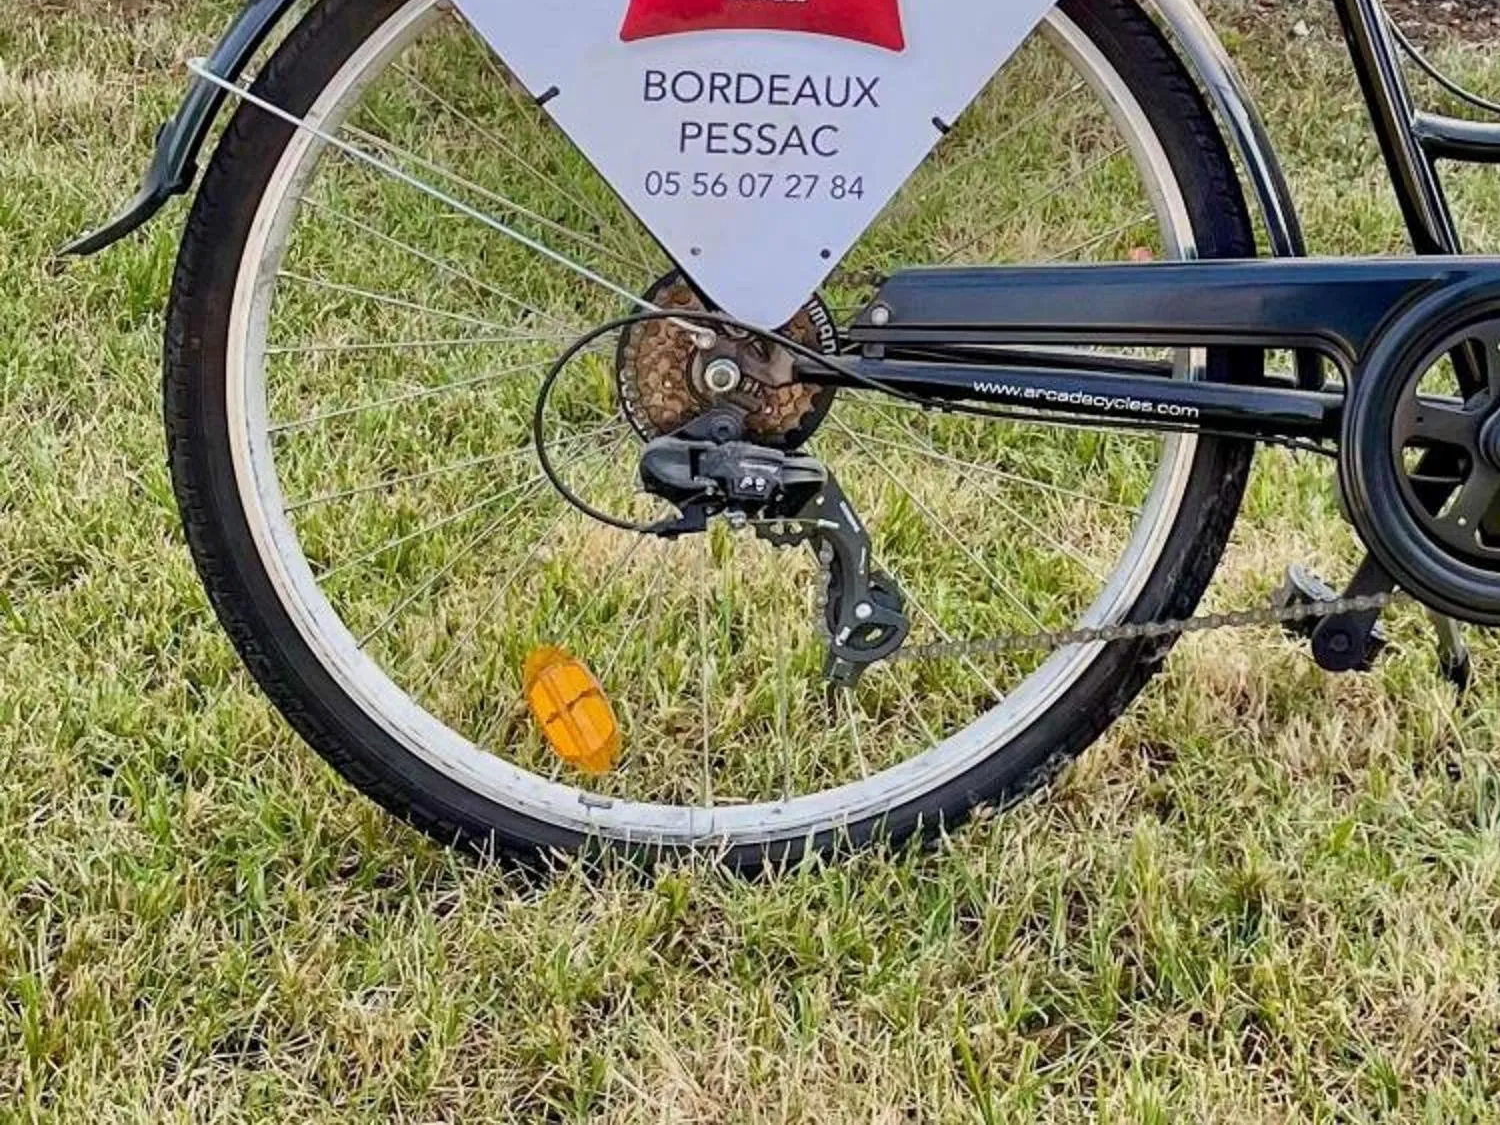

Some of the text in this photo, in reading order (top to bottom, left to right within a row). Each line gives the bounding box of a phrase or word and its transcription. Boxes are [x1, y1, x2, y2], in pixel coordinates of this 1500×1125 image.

[643, 69, 881, 108] BORDEAUX
[679, 121, 840, 158] PESSAC
[644, 170, 865, 200] 05 56 07 27 84
[973, 379, 1200, 419] www.arcadecycles.com
